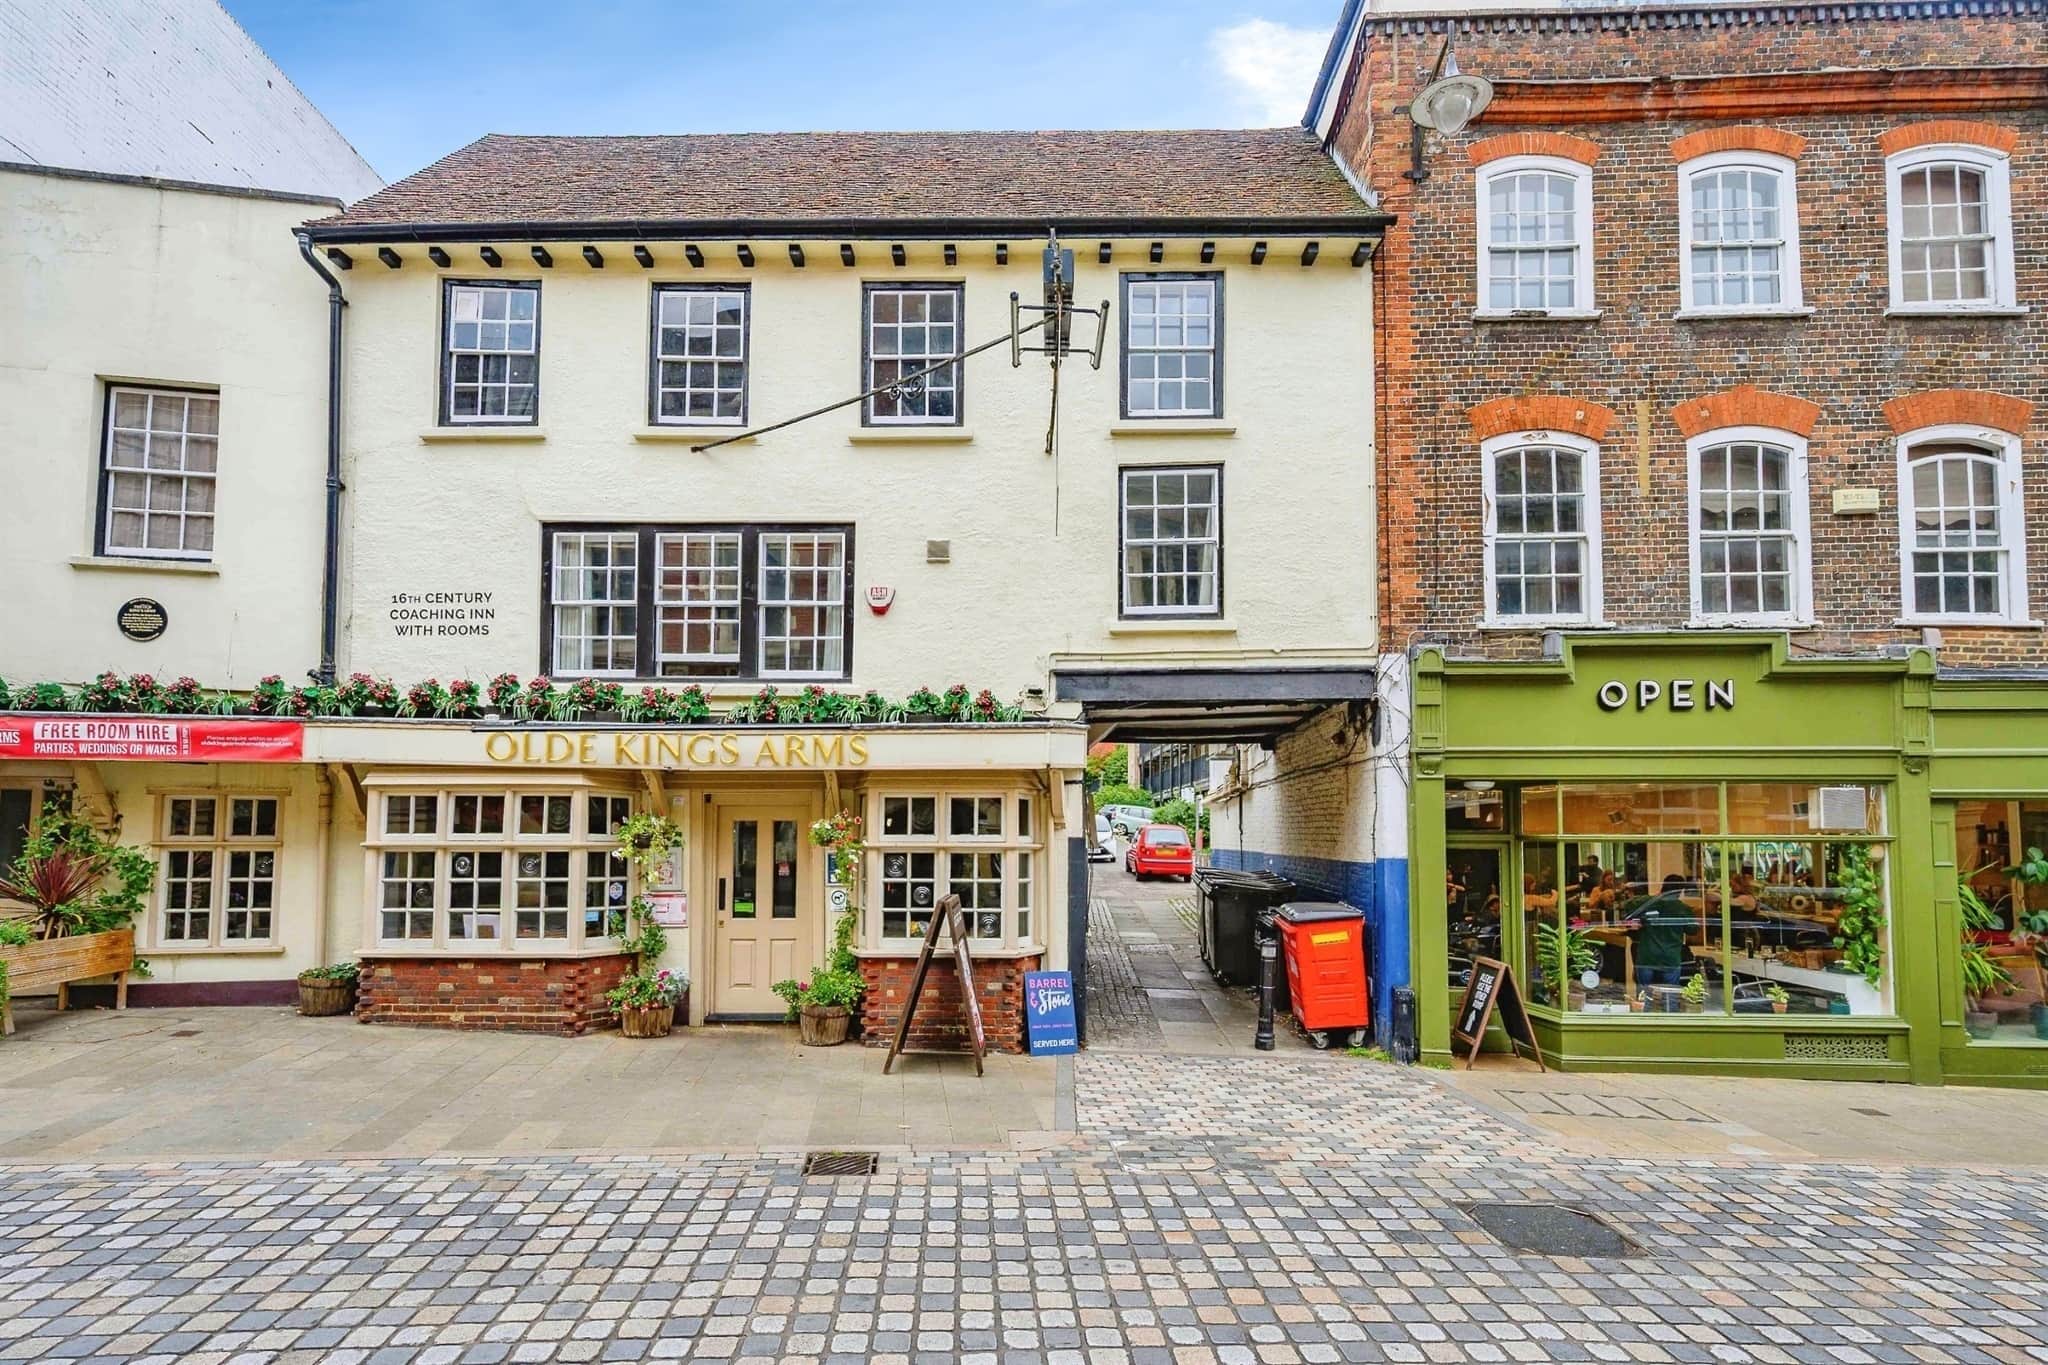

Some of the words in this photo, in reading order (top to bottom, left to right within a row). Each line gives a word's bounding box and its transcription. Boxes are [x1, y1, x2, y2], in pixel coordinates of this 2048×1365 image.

[391, 593, 421, 604] 16TH
[425, 592, 492, 604] CENTURY
[390, 608, 465, 620] COACHING
[470, 608, 495, 620] INN
[395, 624, 433, 636] WITH
[438, 624, 490, 636] ROOMS
[1597, 679, 1734, 711] OPEN
[41, 723, 80, 739] FREE
[87, 723, 130, 739] ROOM
[136, 724, 170, 740] HIRE
[34, 742, 76, 754] PARTIES,
[79, 743, 128, 755] WEDDINGS
[130, 743, 143, 755] OR
[145, 744, 178, 756] WAKES
[485, 731, 598, 763] OLDE
[614, 732, 740, 765] KINGS
[753, 734, 869, 766] ARMS
[1029, 979, 1069, 988] BARREL
[1038, 988, 1071, 1015] Stone
[1033, 1040, 1058, 1048] SERVED
[1059, 1039, 1074, 1047] HERE
